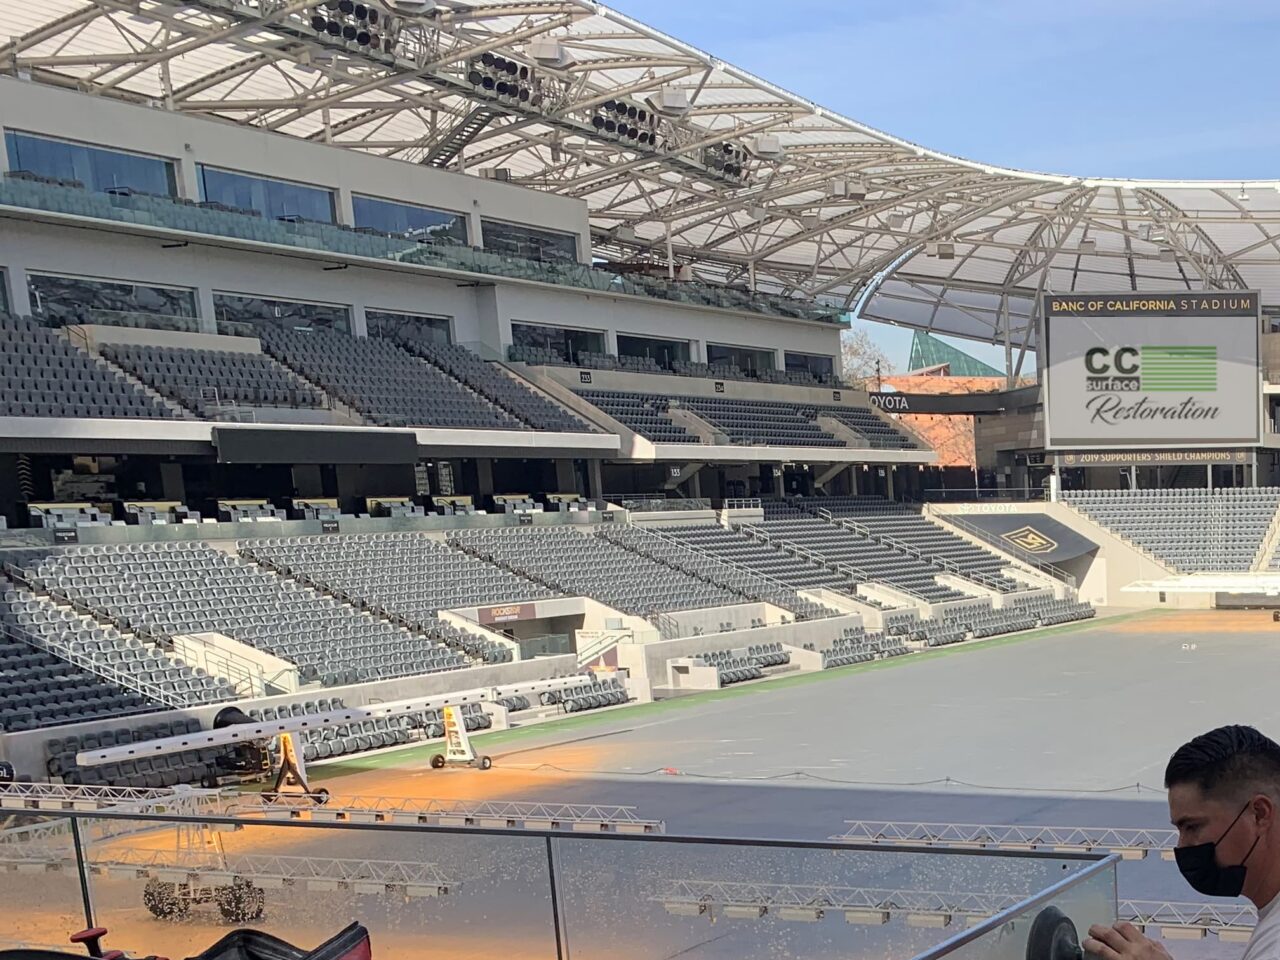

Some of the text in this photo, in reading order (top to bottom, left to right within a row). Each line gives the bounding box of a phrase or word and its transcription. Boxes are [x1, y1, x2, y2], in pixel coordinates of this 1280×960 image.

[1052, 299, 1250, 311] BANC OF CALIFORNIA STADIUM
[1085, 347, 1140, 374] CC
[1086, 377, 1140, 392] surface
[870, 395, 909, 409] OYOTA
[1086, 393, 1220, 426] Restoration
[1080, 453, 1099, 463] 2019
[1155, 452, 1183, 461] SHIELD
[1185, 452, 1230, 461] CHAMPIONS
